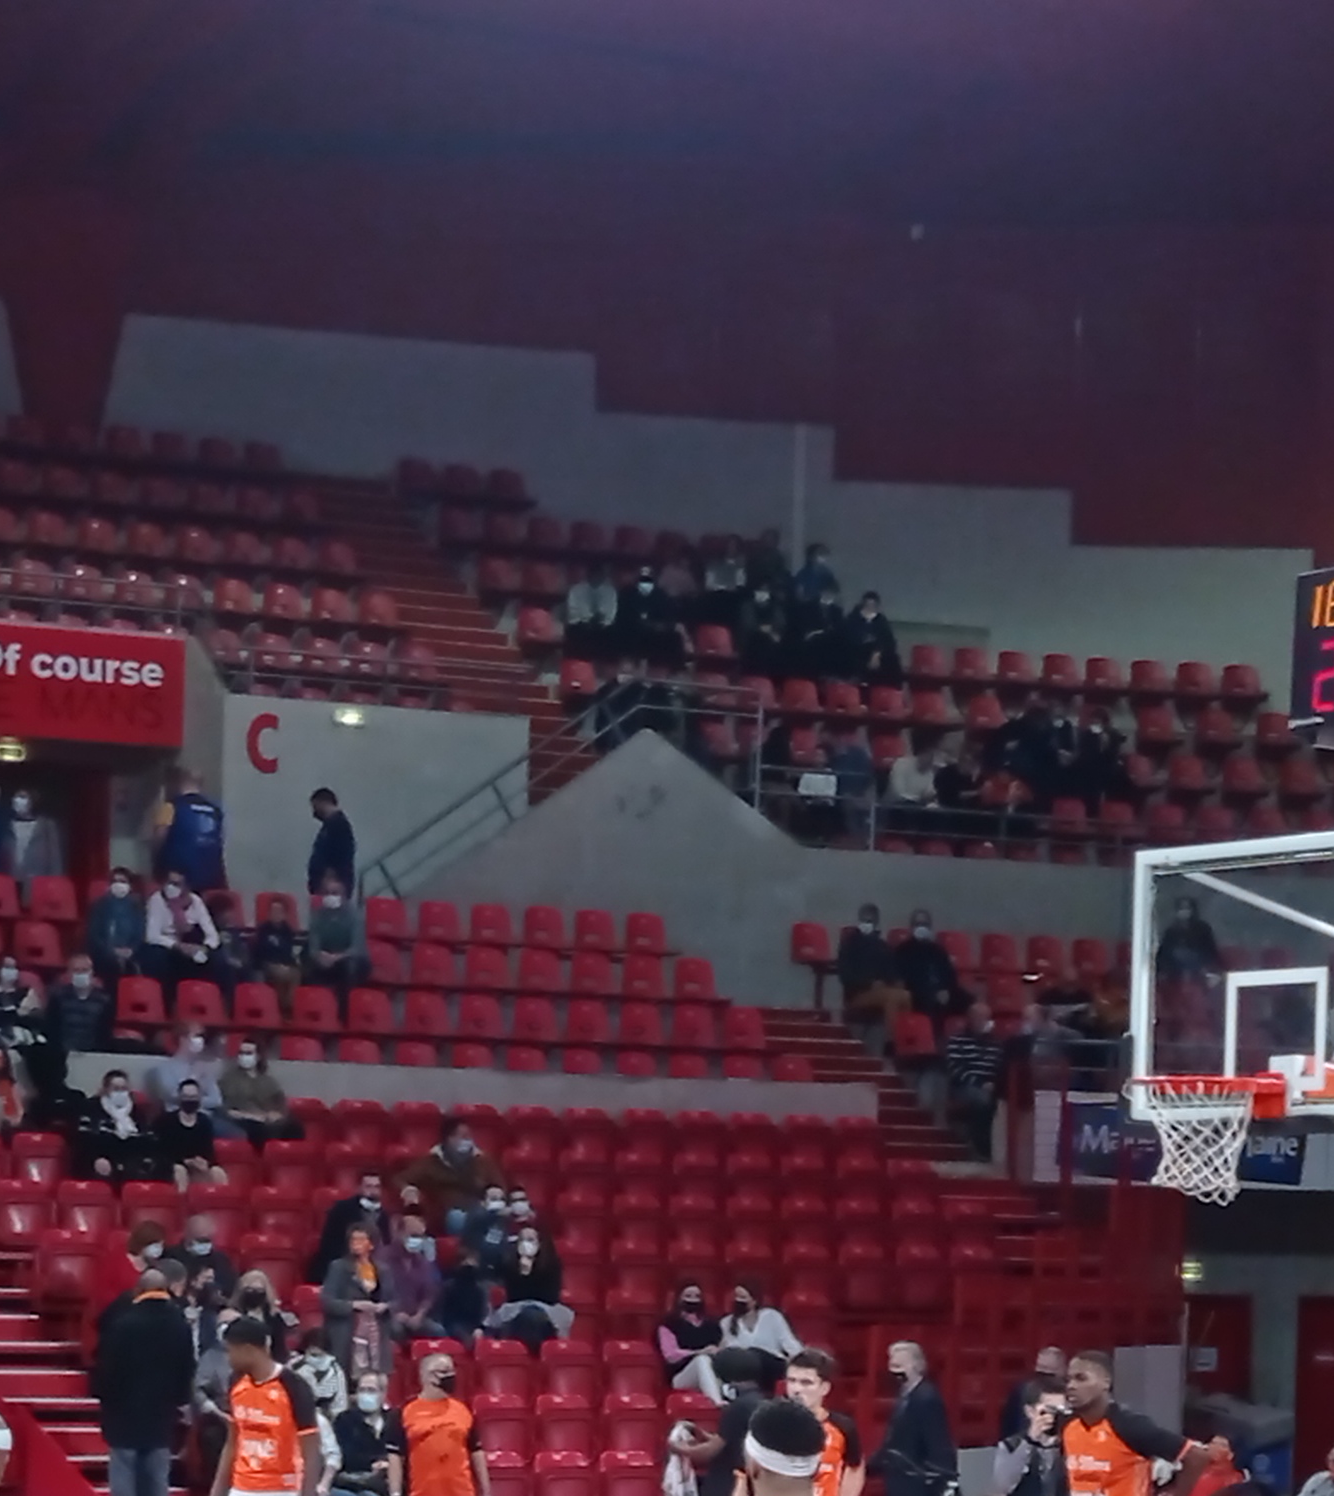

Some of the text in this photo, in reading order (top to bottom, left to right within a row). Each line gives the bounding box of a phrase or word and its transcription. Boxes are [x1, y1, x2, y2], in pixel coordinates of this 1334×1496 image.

[30, 652, 165, 688] course
[246, 712, 280, 775] C
[1244, 1131, 1298, 1158] aine
